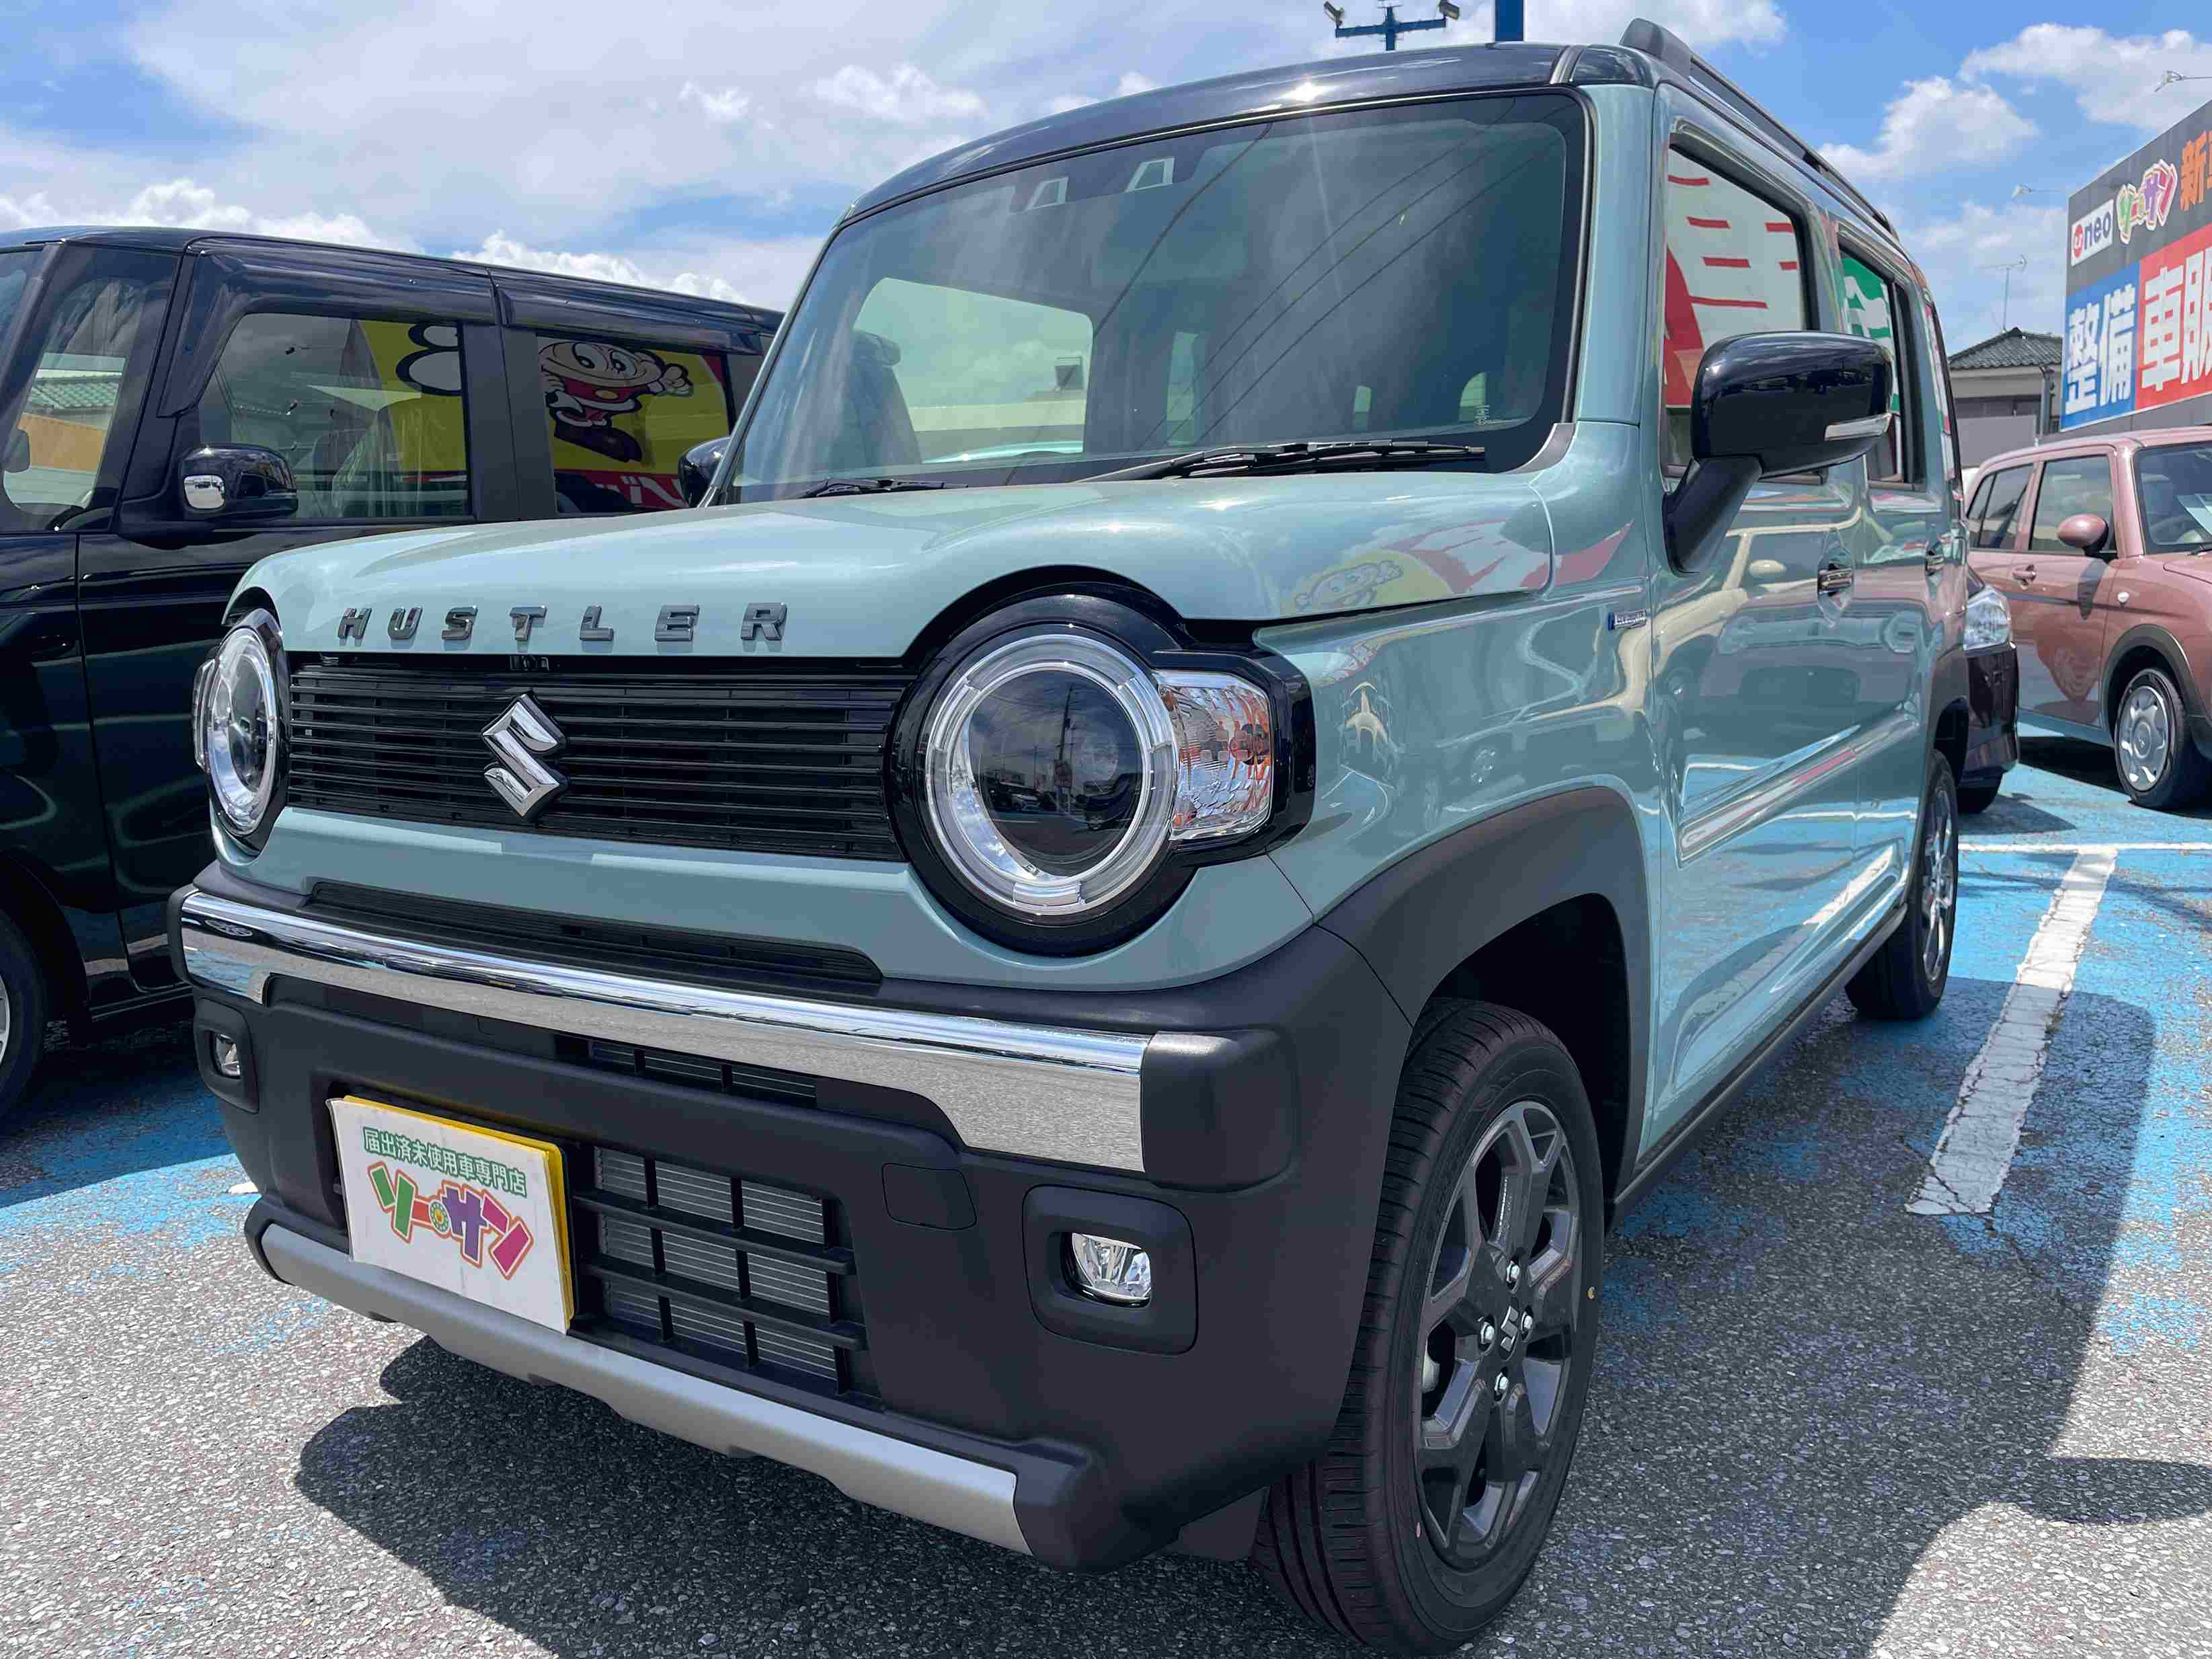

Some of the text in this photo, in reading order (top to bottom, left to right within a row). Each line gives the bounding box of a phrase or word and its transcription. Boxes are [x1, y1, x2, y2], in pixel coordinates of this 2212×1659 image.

[2065, 283, 2135, 414] 整備
[337, 603, 787, 642] HUSTLER
[363, 1126, 527, 1198] 届出済未使用車専門店
